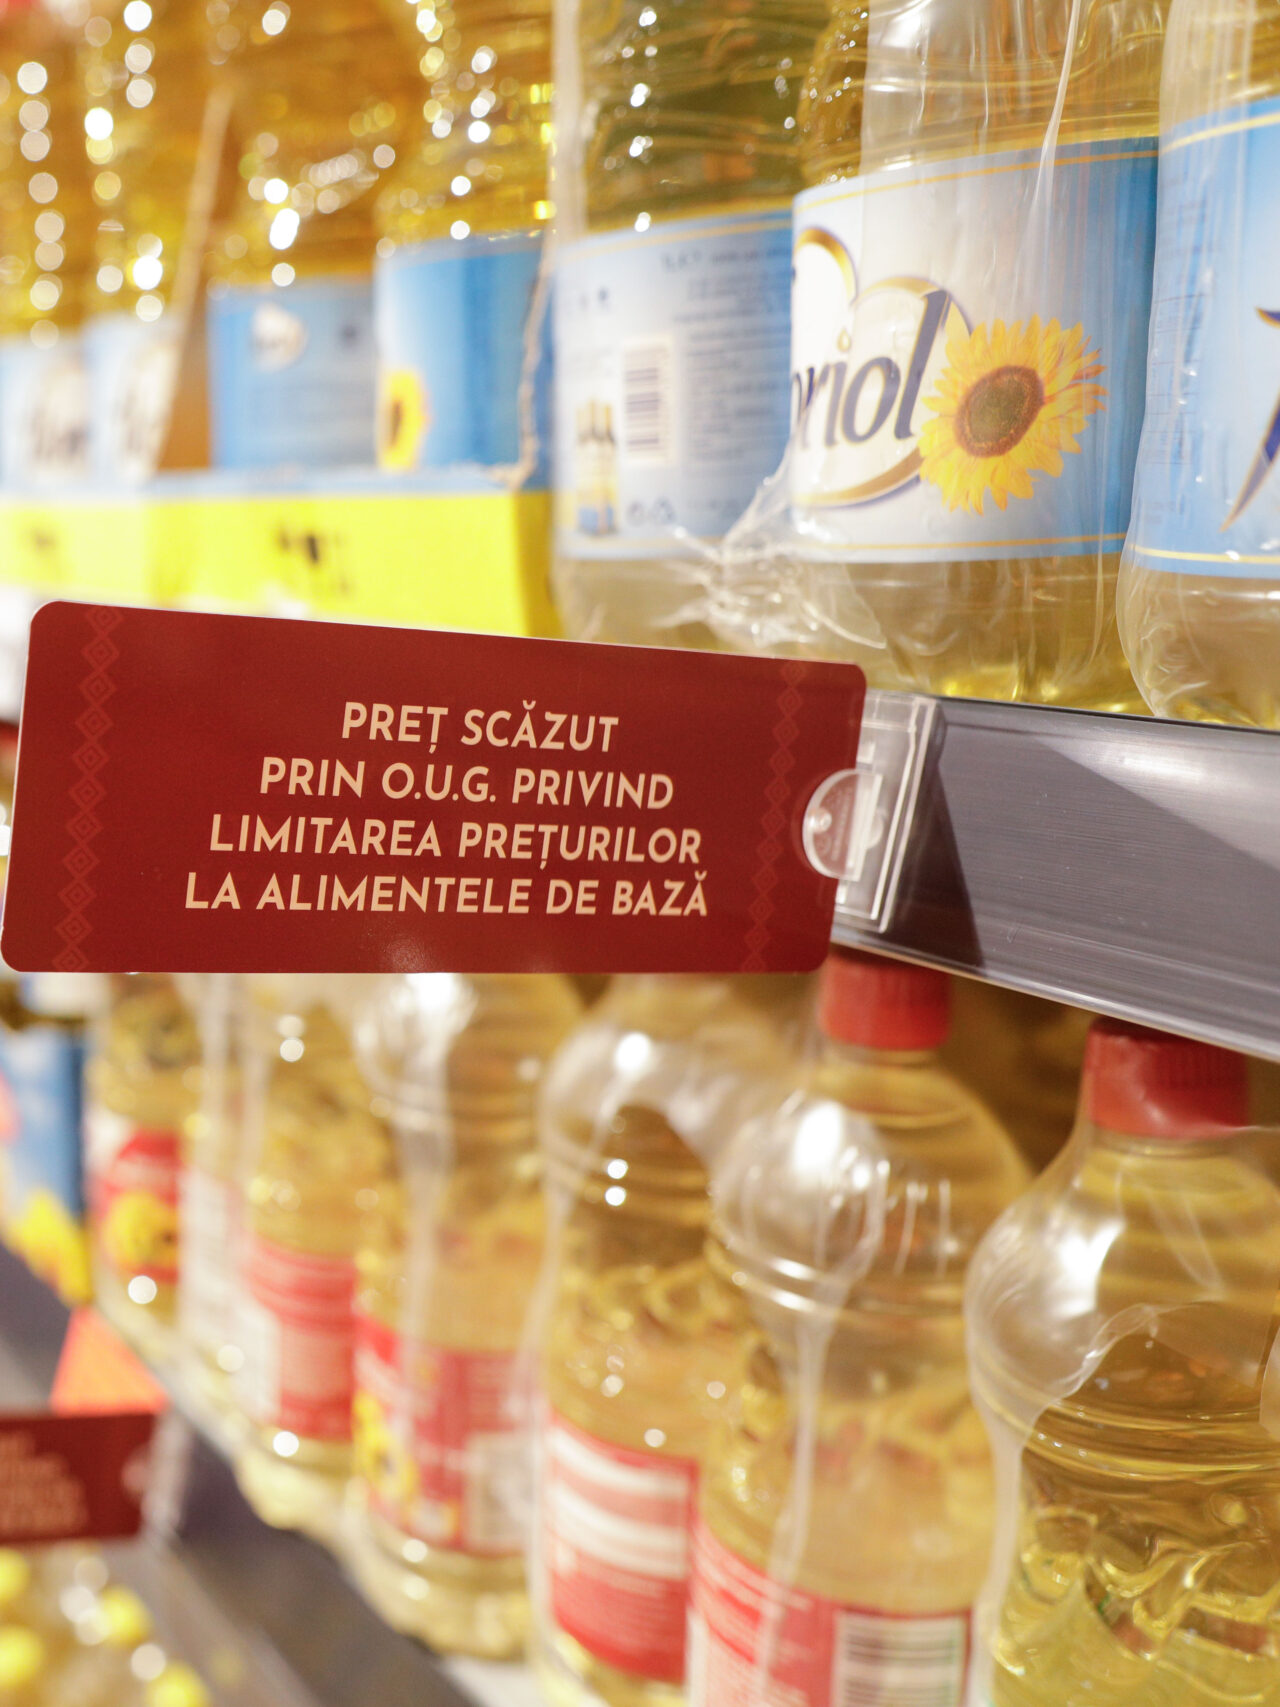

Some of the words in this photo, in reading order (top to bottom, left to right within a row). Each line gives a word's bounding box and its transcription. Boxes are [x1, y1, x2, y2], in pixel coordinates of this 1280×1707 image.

[341, 701, 449, 754] PREȚ
[460, 699, 619, 753] SCĂZUT
[260, 756, 366, 798] PRIN
[381, 762, 497, 803] O.U.G.
[511, 767, 674, 809] PRIVIND
[209, 813, 442, 857] LIMITAREA
[458, 821, 701, 870] PREȚURILOR
[185, 871, 241, 910] LA
[255, 872, 533, 914] ALIMENTELE
[546, 879, 599, 915] DE
[611, 870, 707, 916] BAZĂ
